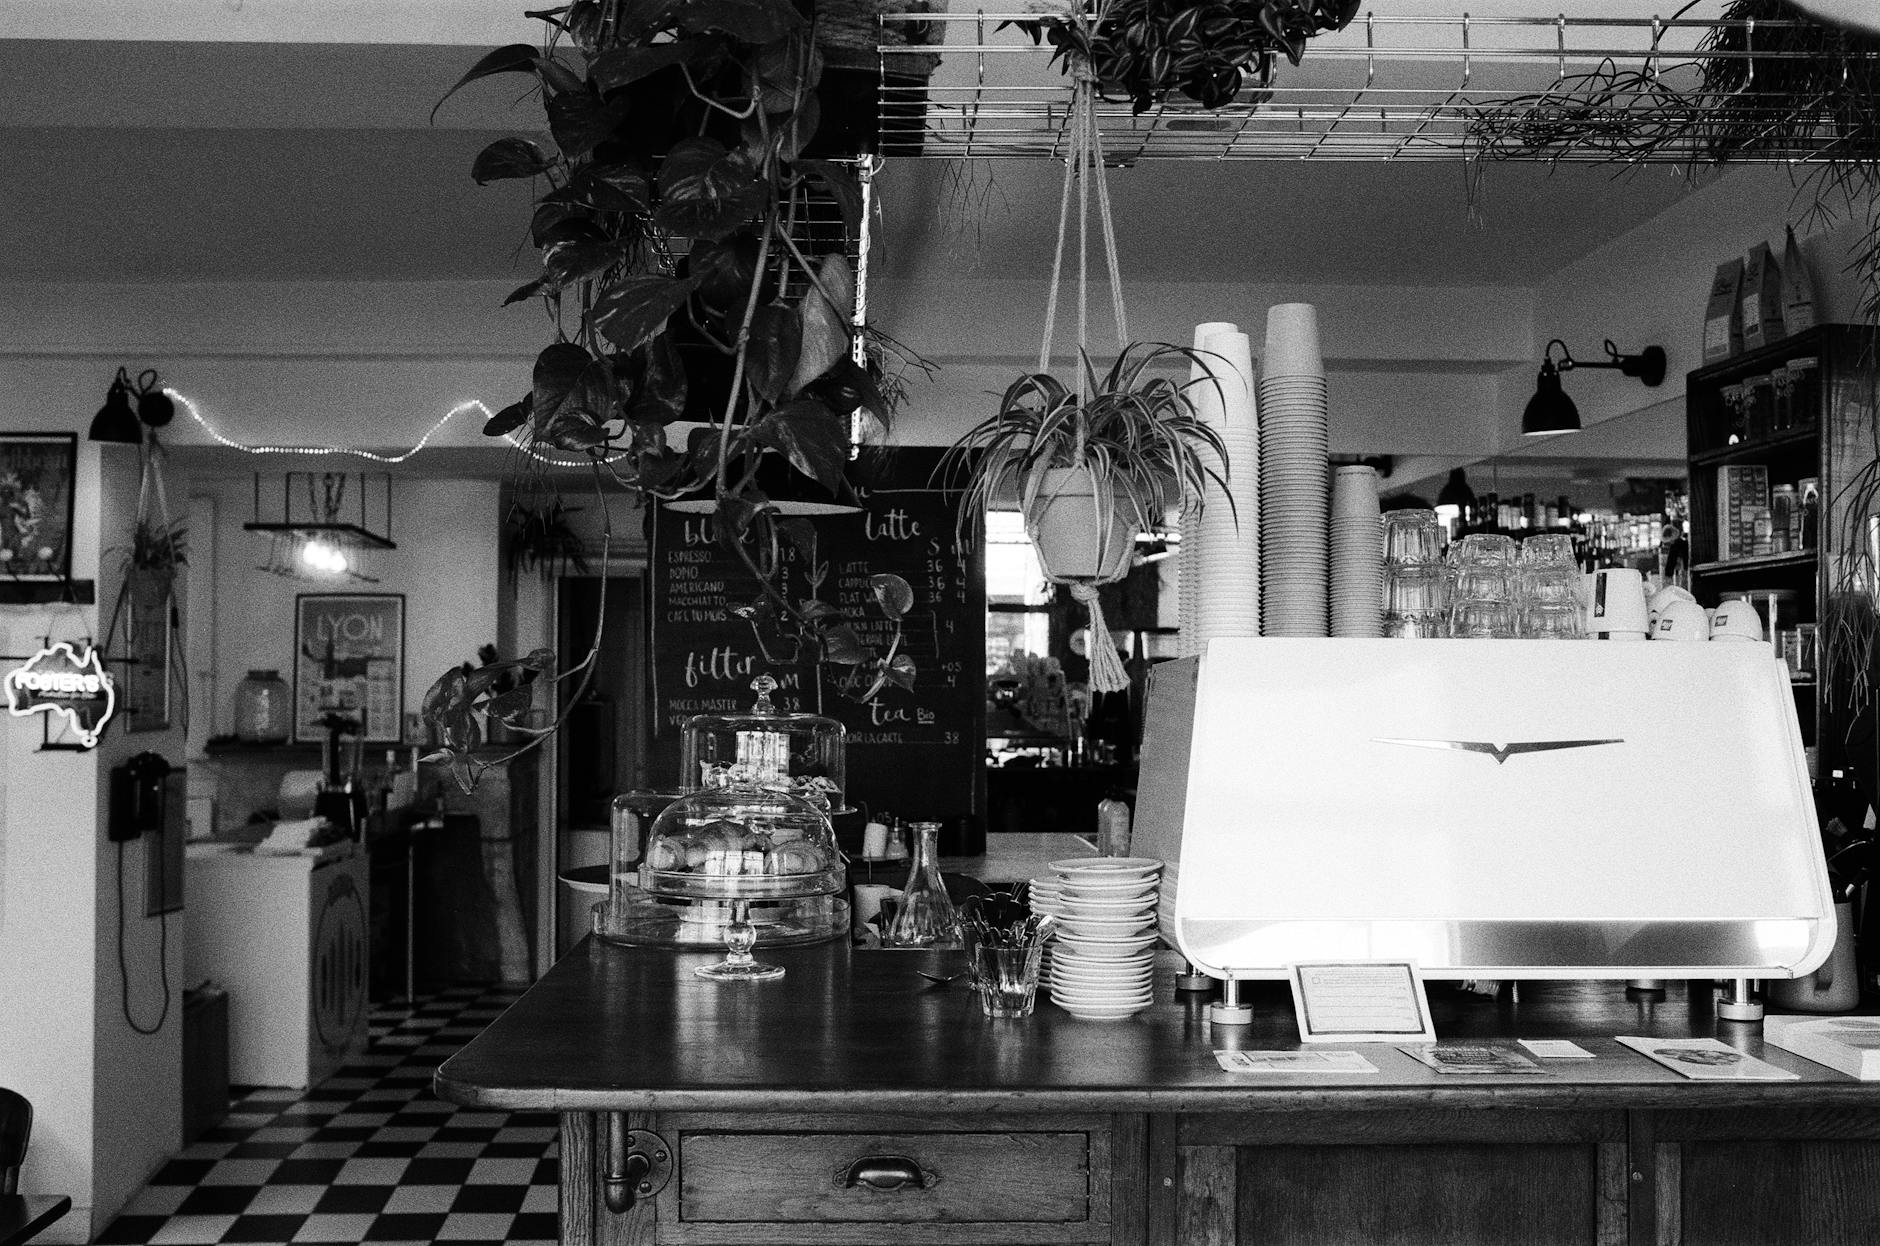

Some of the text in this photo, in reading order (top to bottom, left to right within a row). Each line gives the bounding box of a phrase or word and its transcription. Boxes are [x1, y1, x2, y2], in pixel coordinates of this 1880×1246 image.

[864, 508, 921, 541] latte
[667, 550, 712, 564] ESPRESSO
[780, 566, 790, 580] 3
[838, 561, 870, 574] LATTE
[669, 581, 725, 595] AMERICANO
[955, 577, 966, 589] 4
[956, 591, 966, 604] 4
[780, 610, 789, 622] 2
[316, 613, 383, 641] LYON
[945, 619, 954, 634] 4
[684, 645, 756, 688] filter
[15, 671, 100, 693] FOSTER'S
[946, 675, 956, 688] 4
[701, 698, 737, 711] MASTER
[868, 696, 936, 726] tea Bio
